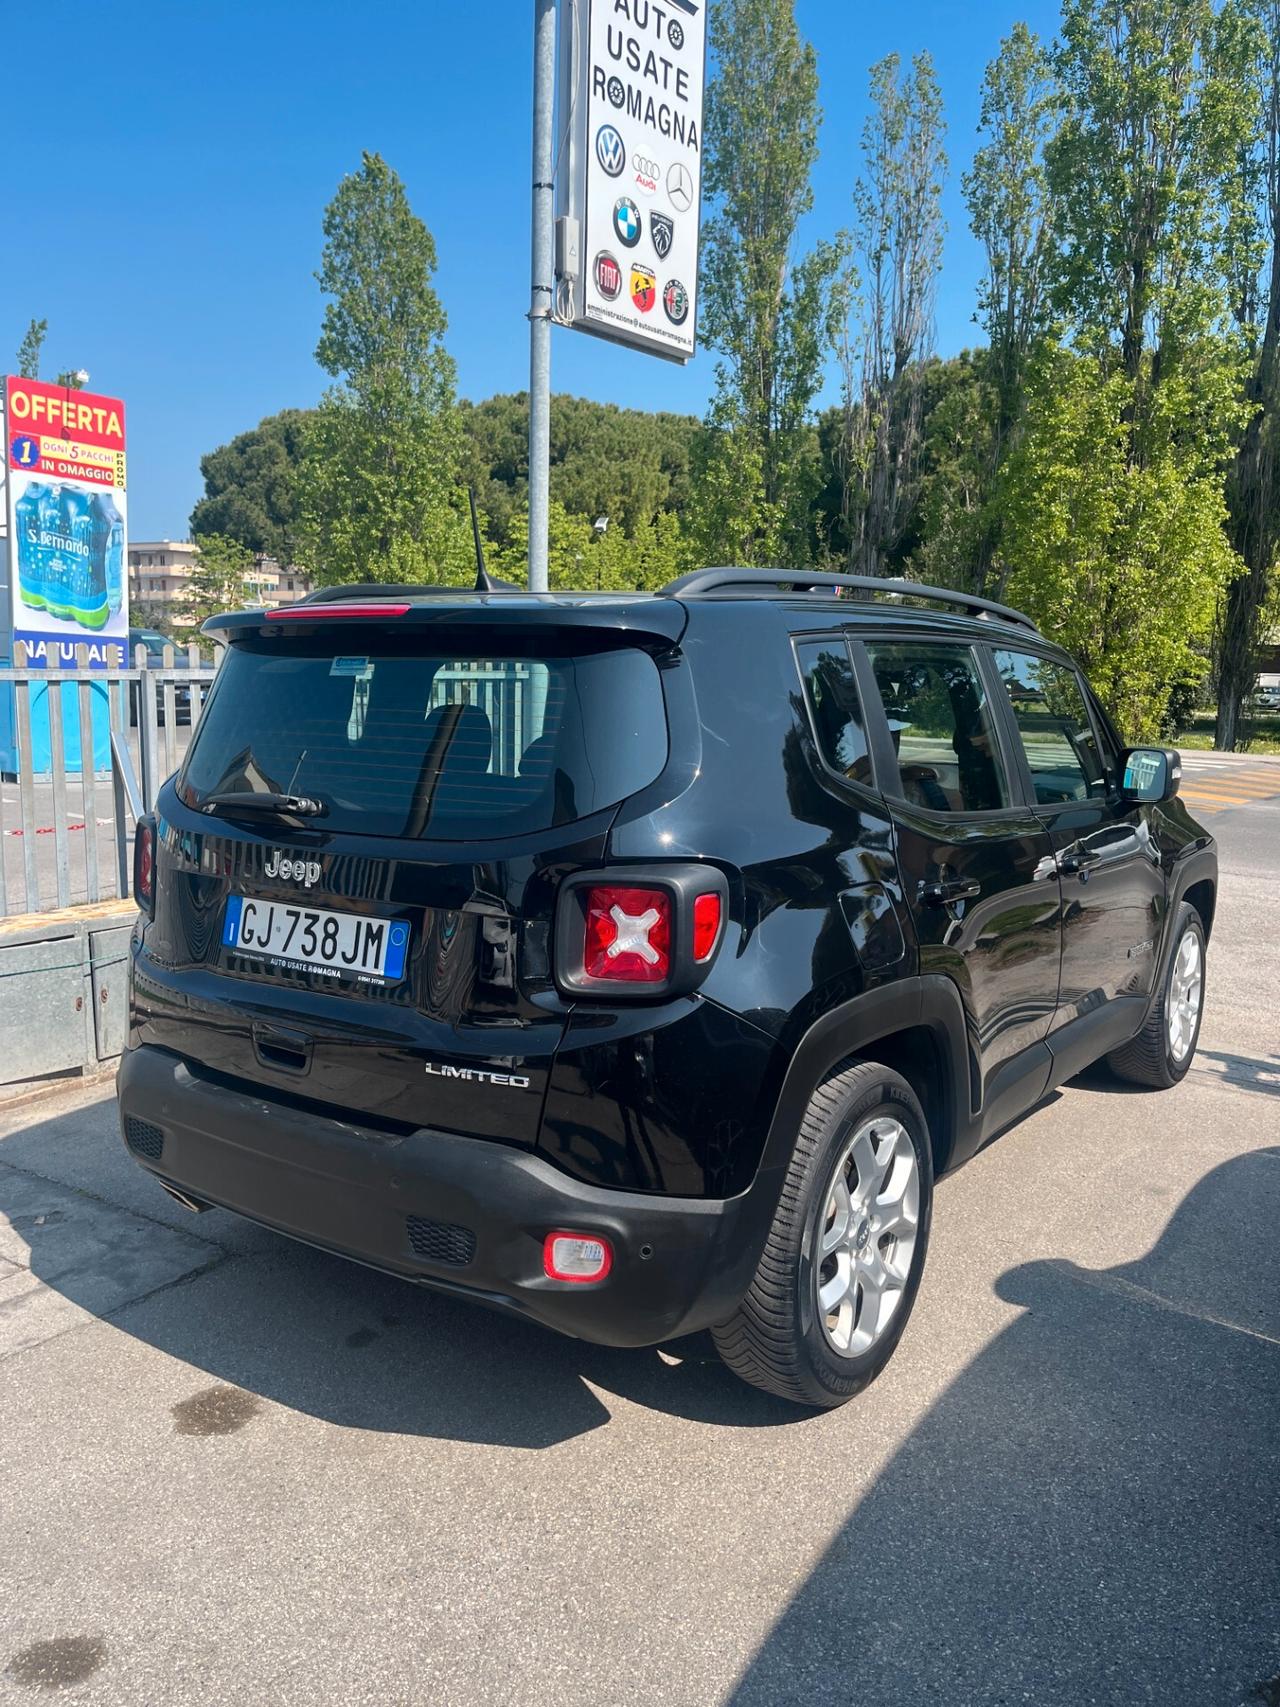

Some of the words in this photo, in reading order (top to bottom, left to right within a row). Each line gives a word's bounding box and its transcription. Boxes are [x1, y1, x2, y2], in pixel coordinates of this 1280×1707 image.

[607, 24, 689, 102] USATE
[593, 65, 699, 152] ROMAGNA
[636, 174, 657, 191] Audi
[600, 264, 618, 290] FIAT
[10, 390, 123, 438] OFFERTA
[20, 441, 31, 463] 1
[43, 442, 68, 454] OGNI
[69, 445, 79, 459] 5
[80, 449, 114, 463] PACCHI
[41, 459, 55, 471] IN
[58, 462, 114, 482] OMAGGIO
[116, 453, 125, 487] PROMO
[19, 639, 124, 663] NAUALE
[264, 850, 322, 887] Jeep
[270, 957, 286, 967] AUTO
[287, 961, 307, 972] USATE
[308, 965, 341, 978] ROMAGNA
[425, 1062, 530, 1088] LIMITED
